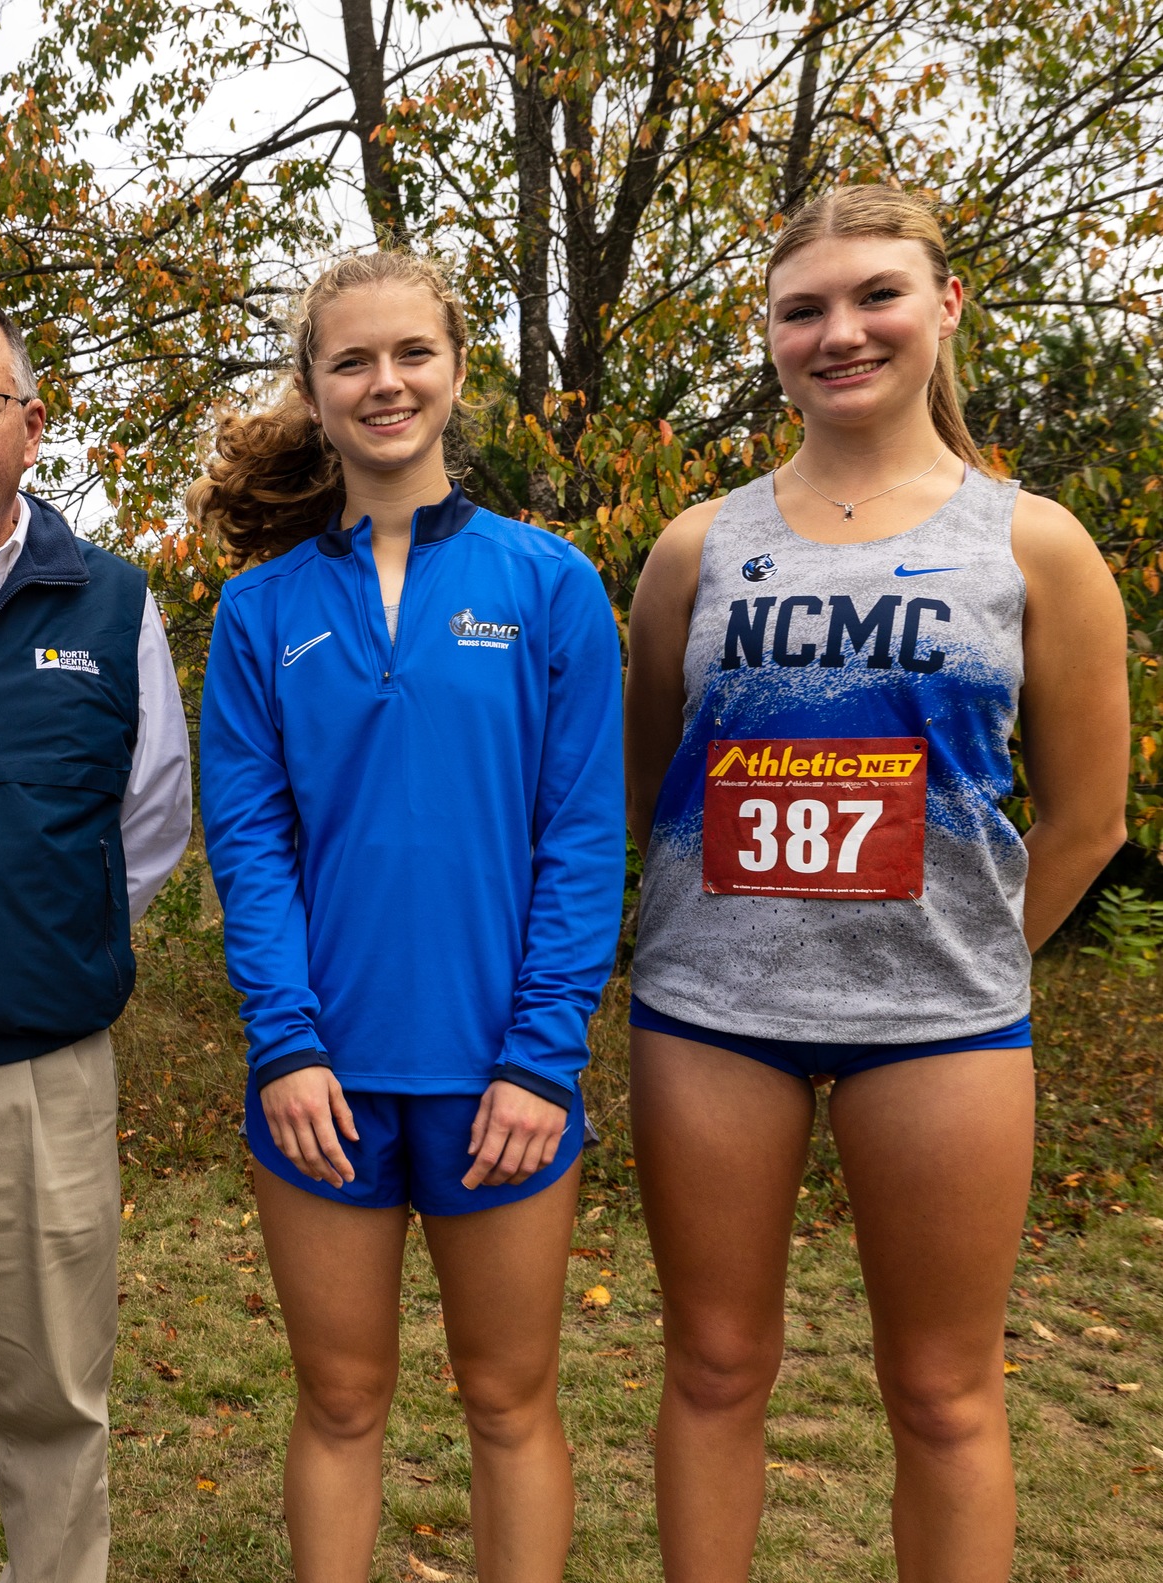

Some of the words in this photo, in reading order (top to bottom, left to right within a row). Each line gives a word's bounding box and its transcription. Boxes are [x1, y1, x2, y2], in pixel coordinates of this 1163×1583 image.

[463, 623, 519, 639] NCMC
[721, 595, 951, 675] NCMC
[480, 640, 509, 649] COUNTRY
[60, 650, 89, 659] NORTH
[60, 658, 98, 668] CENTRAL
[82, 666, 100, 675] COLLEGE
[738, 799, 883, 873] 387
